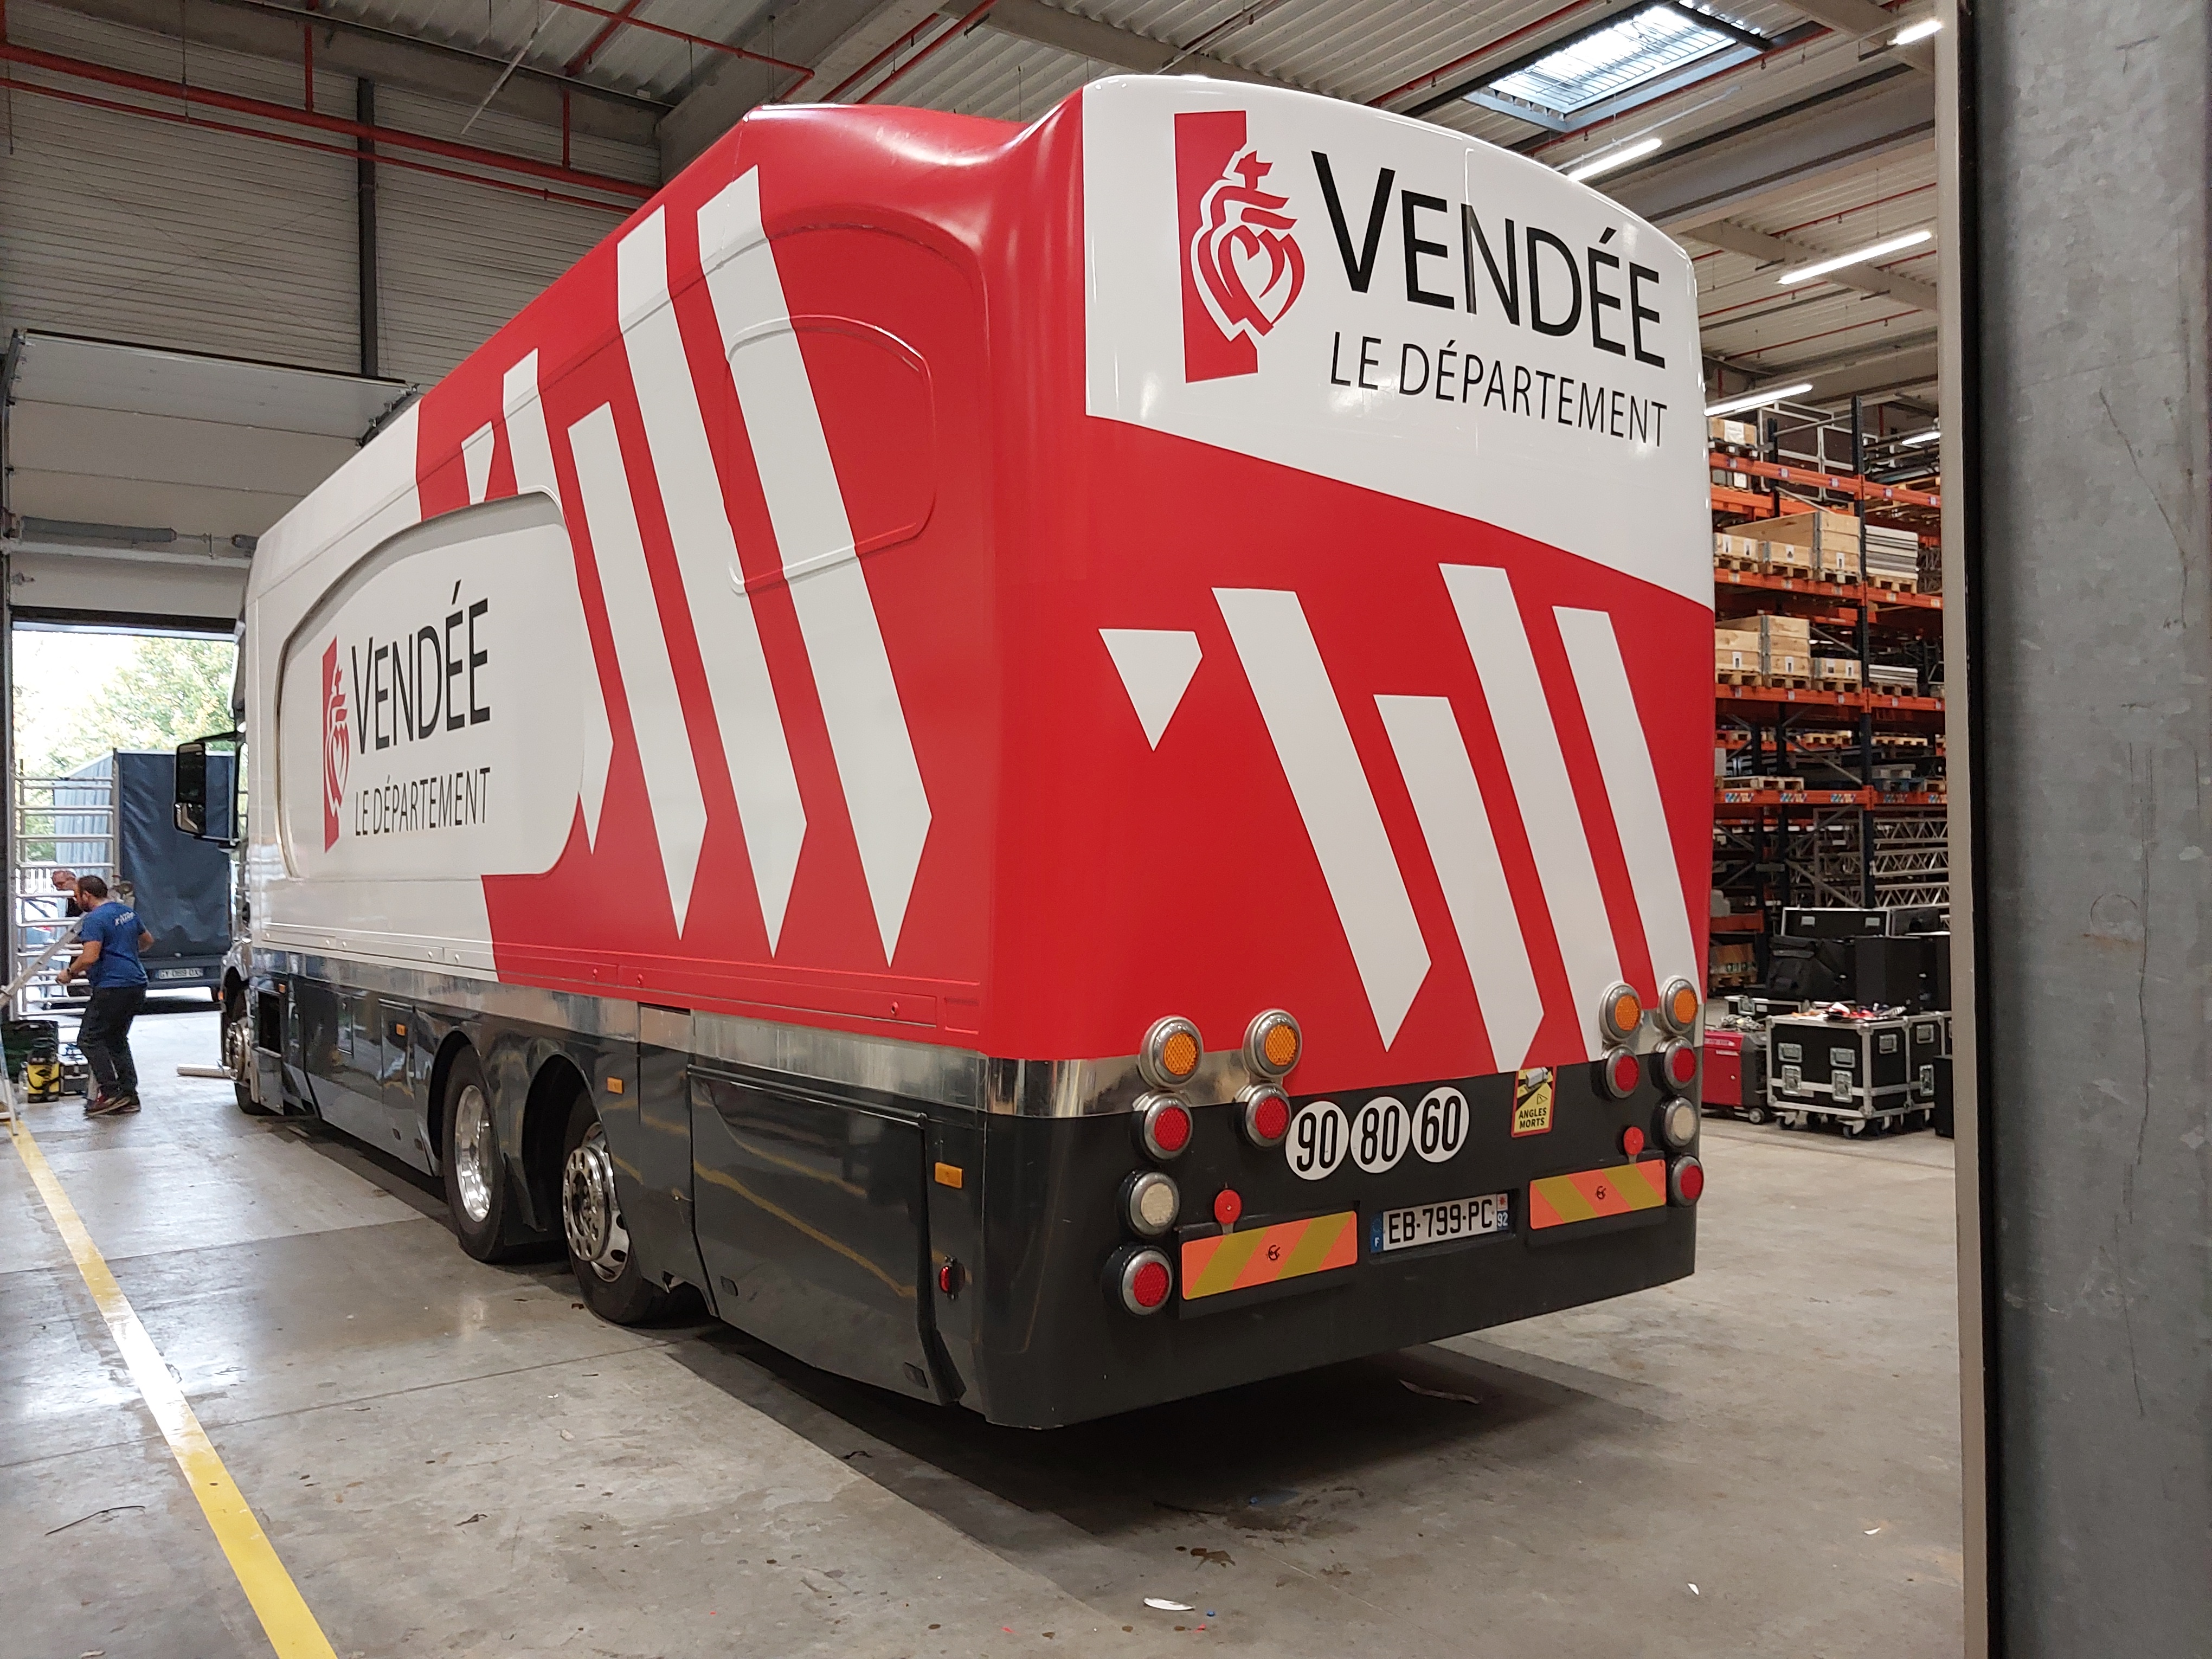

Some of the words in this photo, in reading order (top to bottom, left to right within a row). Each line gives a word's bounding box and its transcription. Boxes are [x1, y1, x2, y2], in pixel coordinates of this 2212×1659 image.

[1310, 150, 1666, 369] VENDÉE
[1330, 331, 1381, 390] LE
[1399, 339, 1667, 447] DÉPARTEMENT
[351, 578, 491, 755] VENDÉE
[356, 790, 369, 836] LE
[373, 767, 491, 834] DÉPARTEMENT
[1296, 1109, 1339, 1172] 90
[1360, 1105, 1400, 1165] 80
[1420, 1095, 1462, 1154] 60
[1519, 1107, 1547, 1120] ANGLES
[1519, 1117, 1545, 1129] MORTS
[1374, 1237, 1380, 1247] F
[1497, 1212, 1509, 1227] 92
